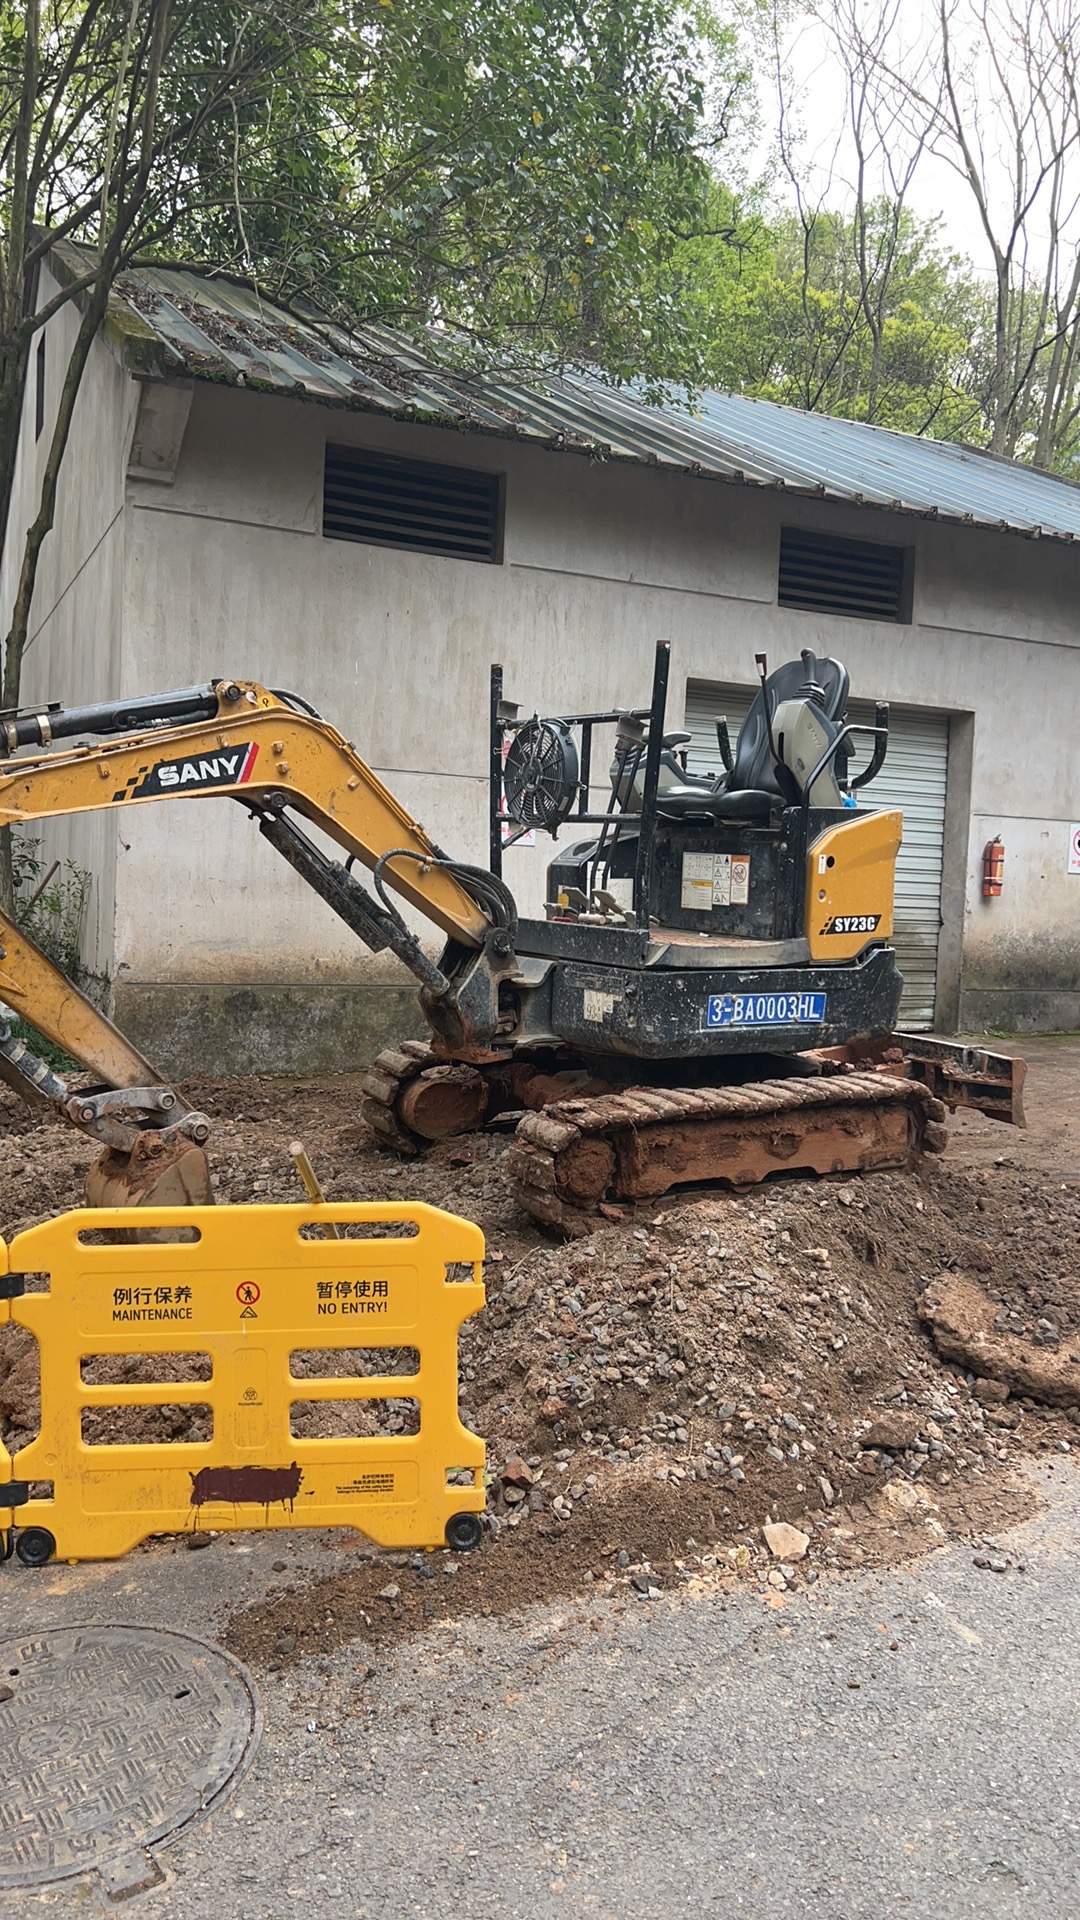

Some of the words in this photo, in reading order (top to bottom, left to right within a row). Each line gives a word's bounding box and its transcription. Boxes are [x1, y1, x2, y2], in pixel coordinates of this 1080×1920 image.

[158, 755, 239, 787] SANY
[834, 916, 875, 932] SY23C
[712, 996, 820, 1022] 3-BA0003HL
[113, 1286, 192, 1305] 例行保养
[316, 1280, 389, 1299] 暂停使用
[112, 1307, 193, 1321] MAINTENANCE
[317, 1303, 337, 1315] NO
[341, 1301, 388, 1314] ENTRY!
